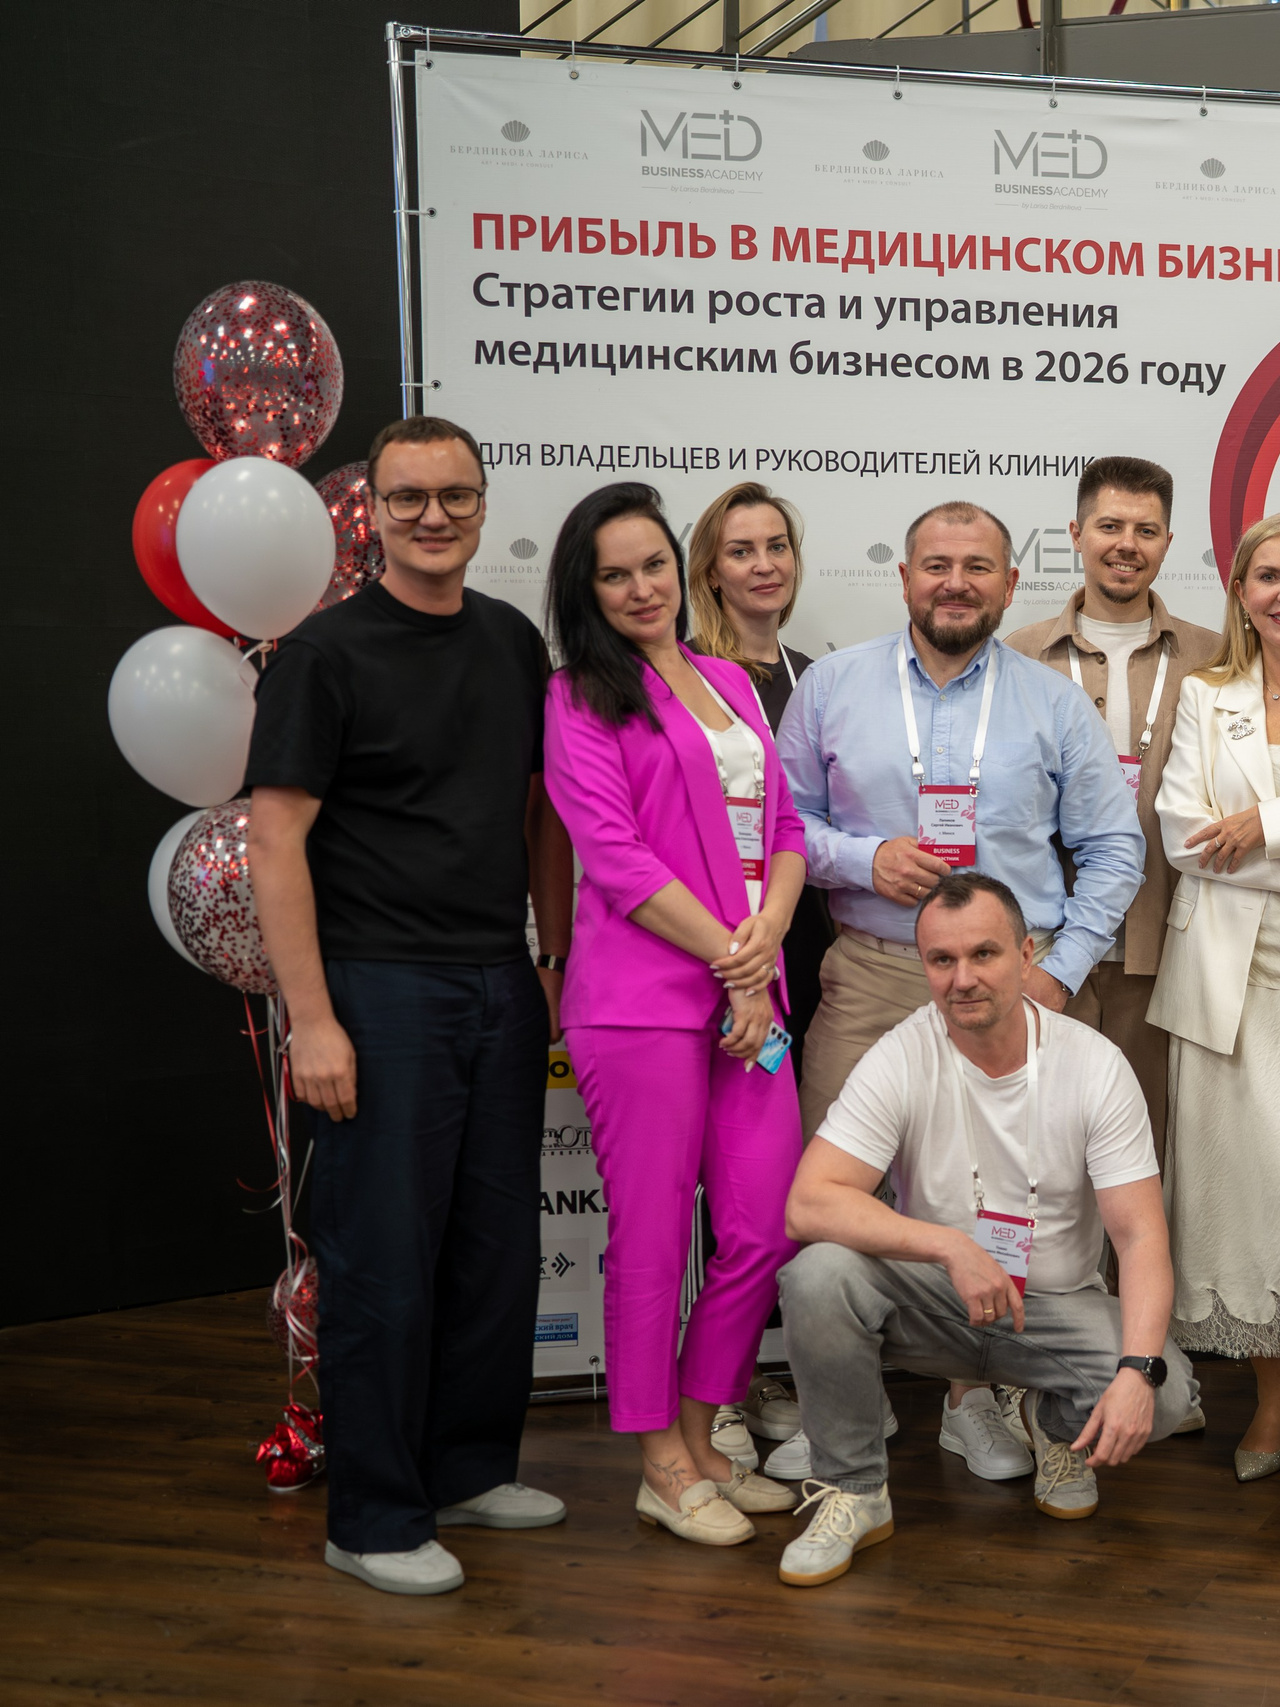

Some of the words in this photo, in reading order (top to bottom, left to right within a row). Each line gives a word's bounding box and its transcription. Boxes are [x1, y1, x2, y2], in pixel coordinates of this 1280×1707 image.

[640, 109, 763, 162] MED
[450, 145, 534, 158] БЕРДНИКОВА
[538, 149, 589, 160] ЛАРИСА
[994, 129, 1108, 179] MED
[641, 165, 763, 181] BUSINESSACADEMY
[814, 164, 893, 176] БЕРДНИКОВА
[897, 168, 945, 179] ЛАРИСА
[994, 183, 1108, 198] BUSINESSACADEMY
[1155, 181, 1228, 193] БЕРДНИКОВА
[1232, 185, 1277, 195] ЛАРИСА
[472, 212, 717, 261] ПРИБЫЛЬ
[731, 225, 760, 261] В
[772, 226, 1146, 277] МЕДИЦИНСКОМ
[472, 272, 695, 317] Стратегии
[708, 288, 826, 323] роста
[838, 295, 863, 321] и
[874, 296, 1118, 331] управления
[475, 337, 778, 376] медицинским
[789, 340, 991, 381] бизнесом
[1001, 357, 1025, 383] в
[1035, 350, 1130, 385] 2026
[1140, 361, 1226, 397] году
[479, 442, 531, 470] ДЛЯ
[540, 443, 721, 474] ВЛАДЕЛЬЦЕВ
[728, 447, 748, 471] И
[755, 447, 981, 479] РУКОВОДИТЕЛЕЙ
[467, 564, 541, 574] ЕРДНИКОВА
[819, 568, 897, 578] БЕРДНИКОВА
[1158, 572, 1220, 581] БЕРДНИКО
[935, 799, 960, 810] MED
